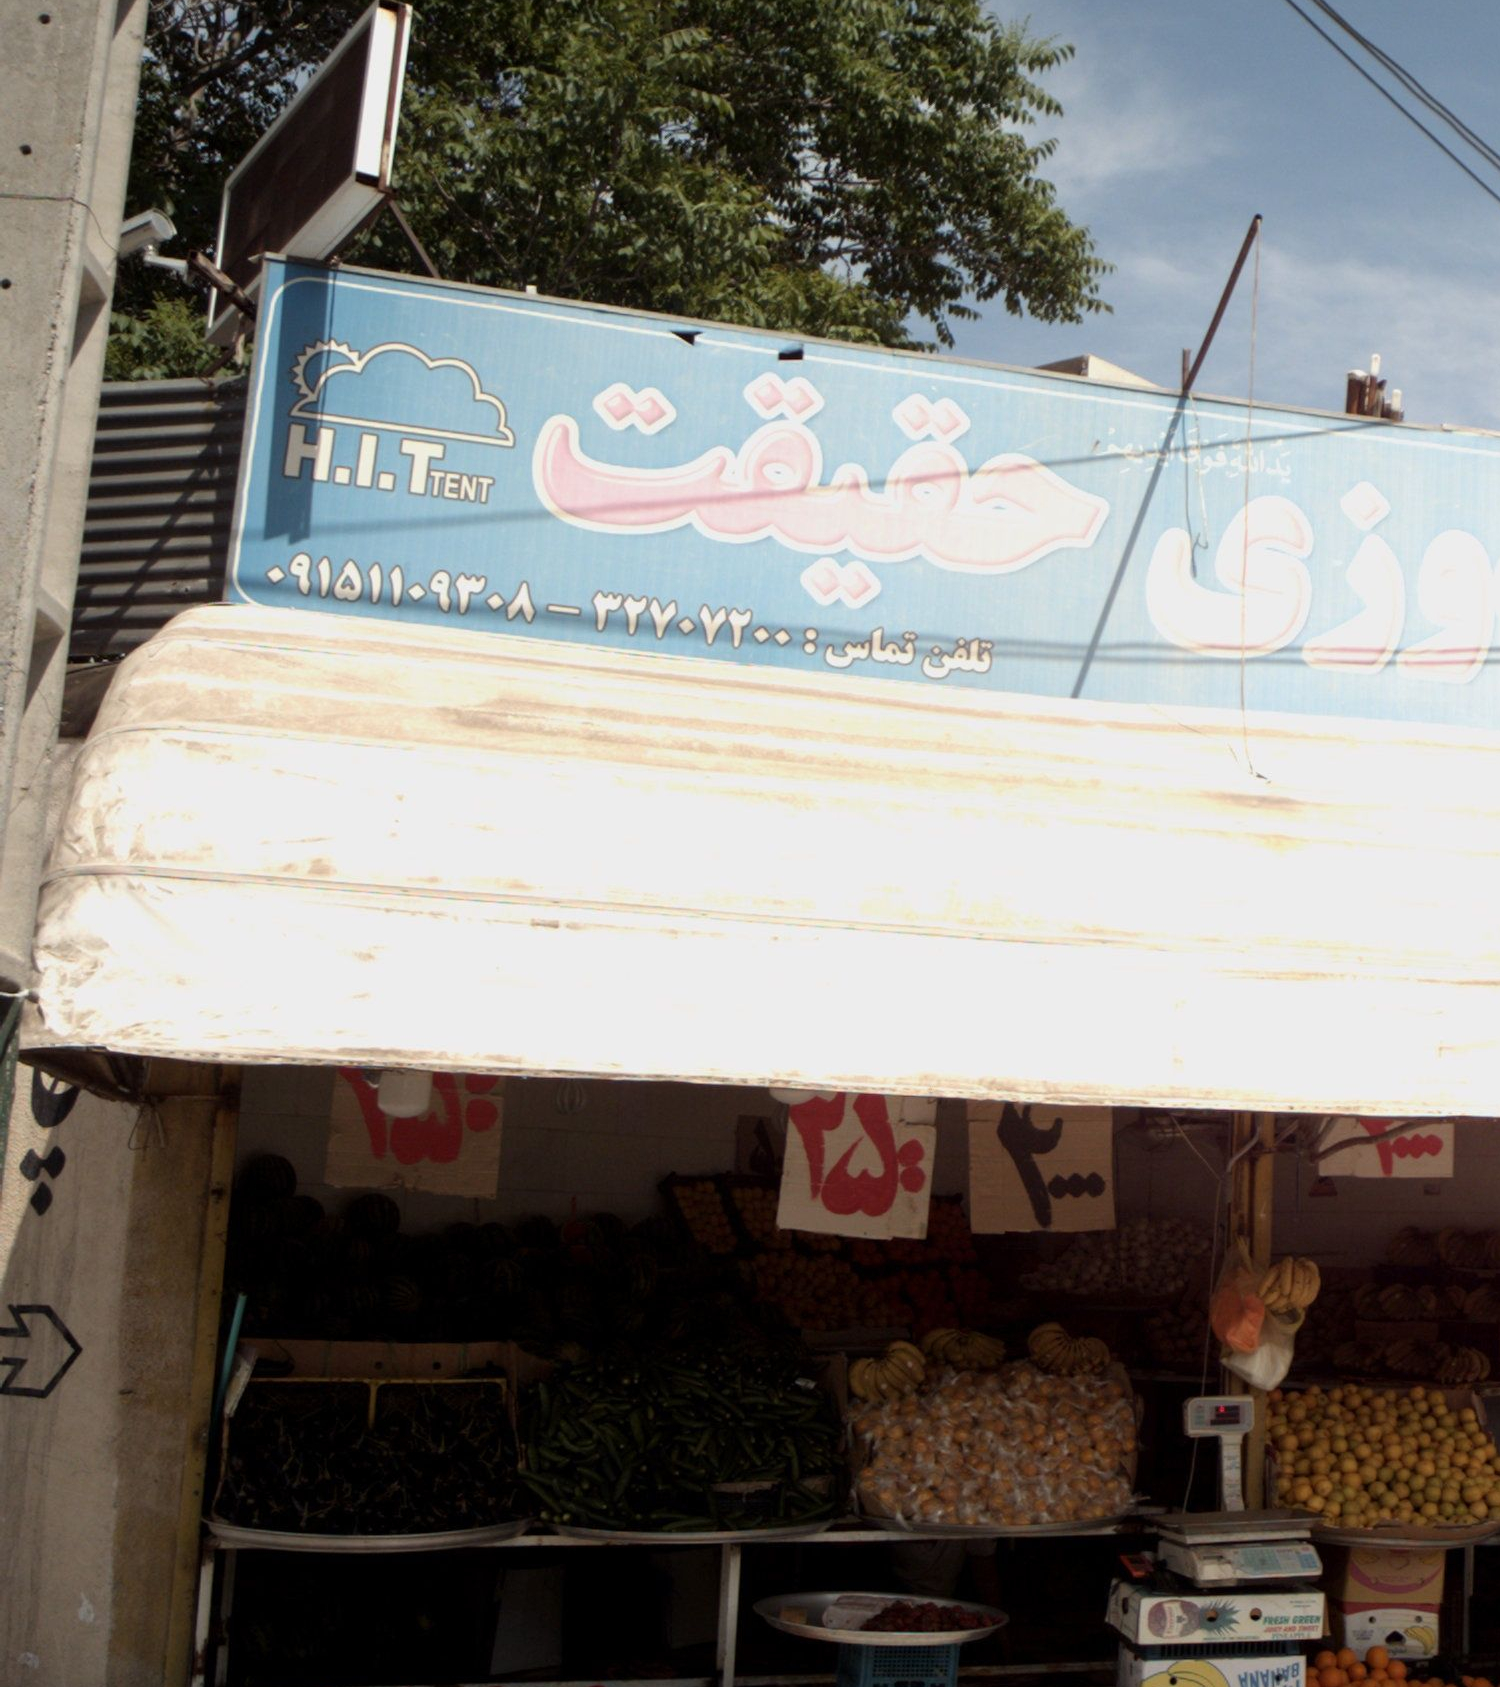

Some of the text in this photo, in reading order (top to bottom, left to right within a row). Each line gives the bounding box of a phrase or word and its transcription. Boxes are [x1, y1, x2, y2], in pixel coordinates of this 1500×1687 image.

[283, 423, 495, 504] H.I.T TENT
[532, 371, 1110, 609] حقیقت
[266, 553, 536, 624] ۰۹۱۵۱۱۰۹۳۰۸
[593, 590, 791, 648] ۳۲۷۰۷۲۰۰
[921, 636, 995, 680] تلفن
[1238, 1662, 1300, 1687] BANANA
